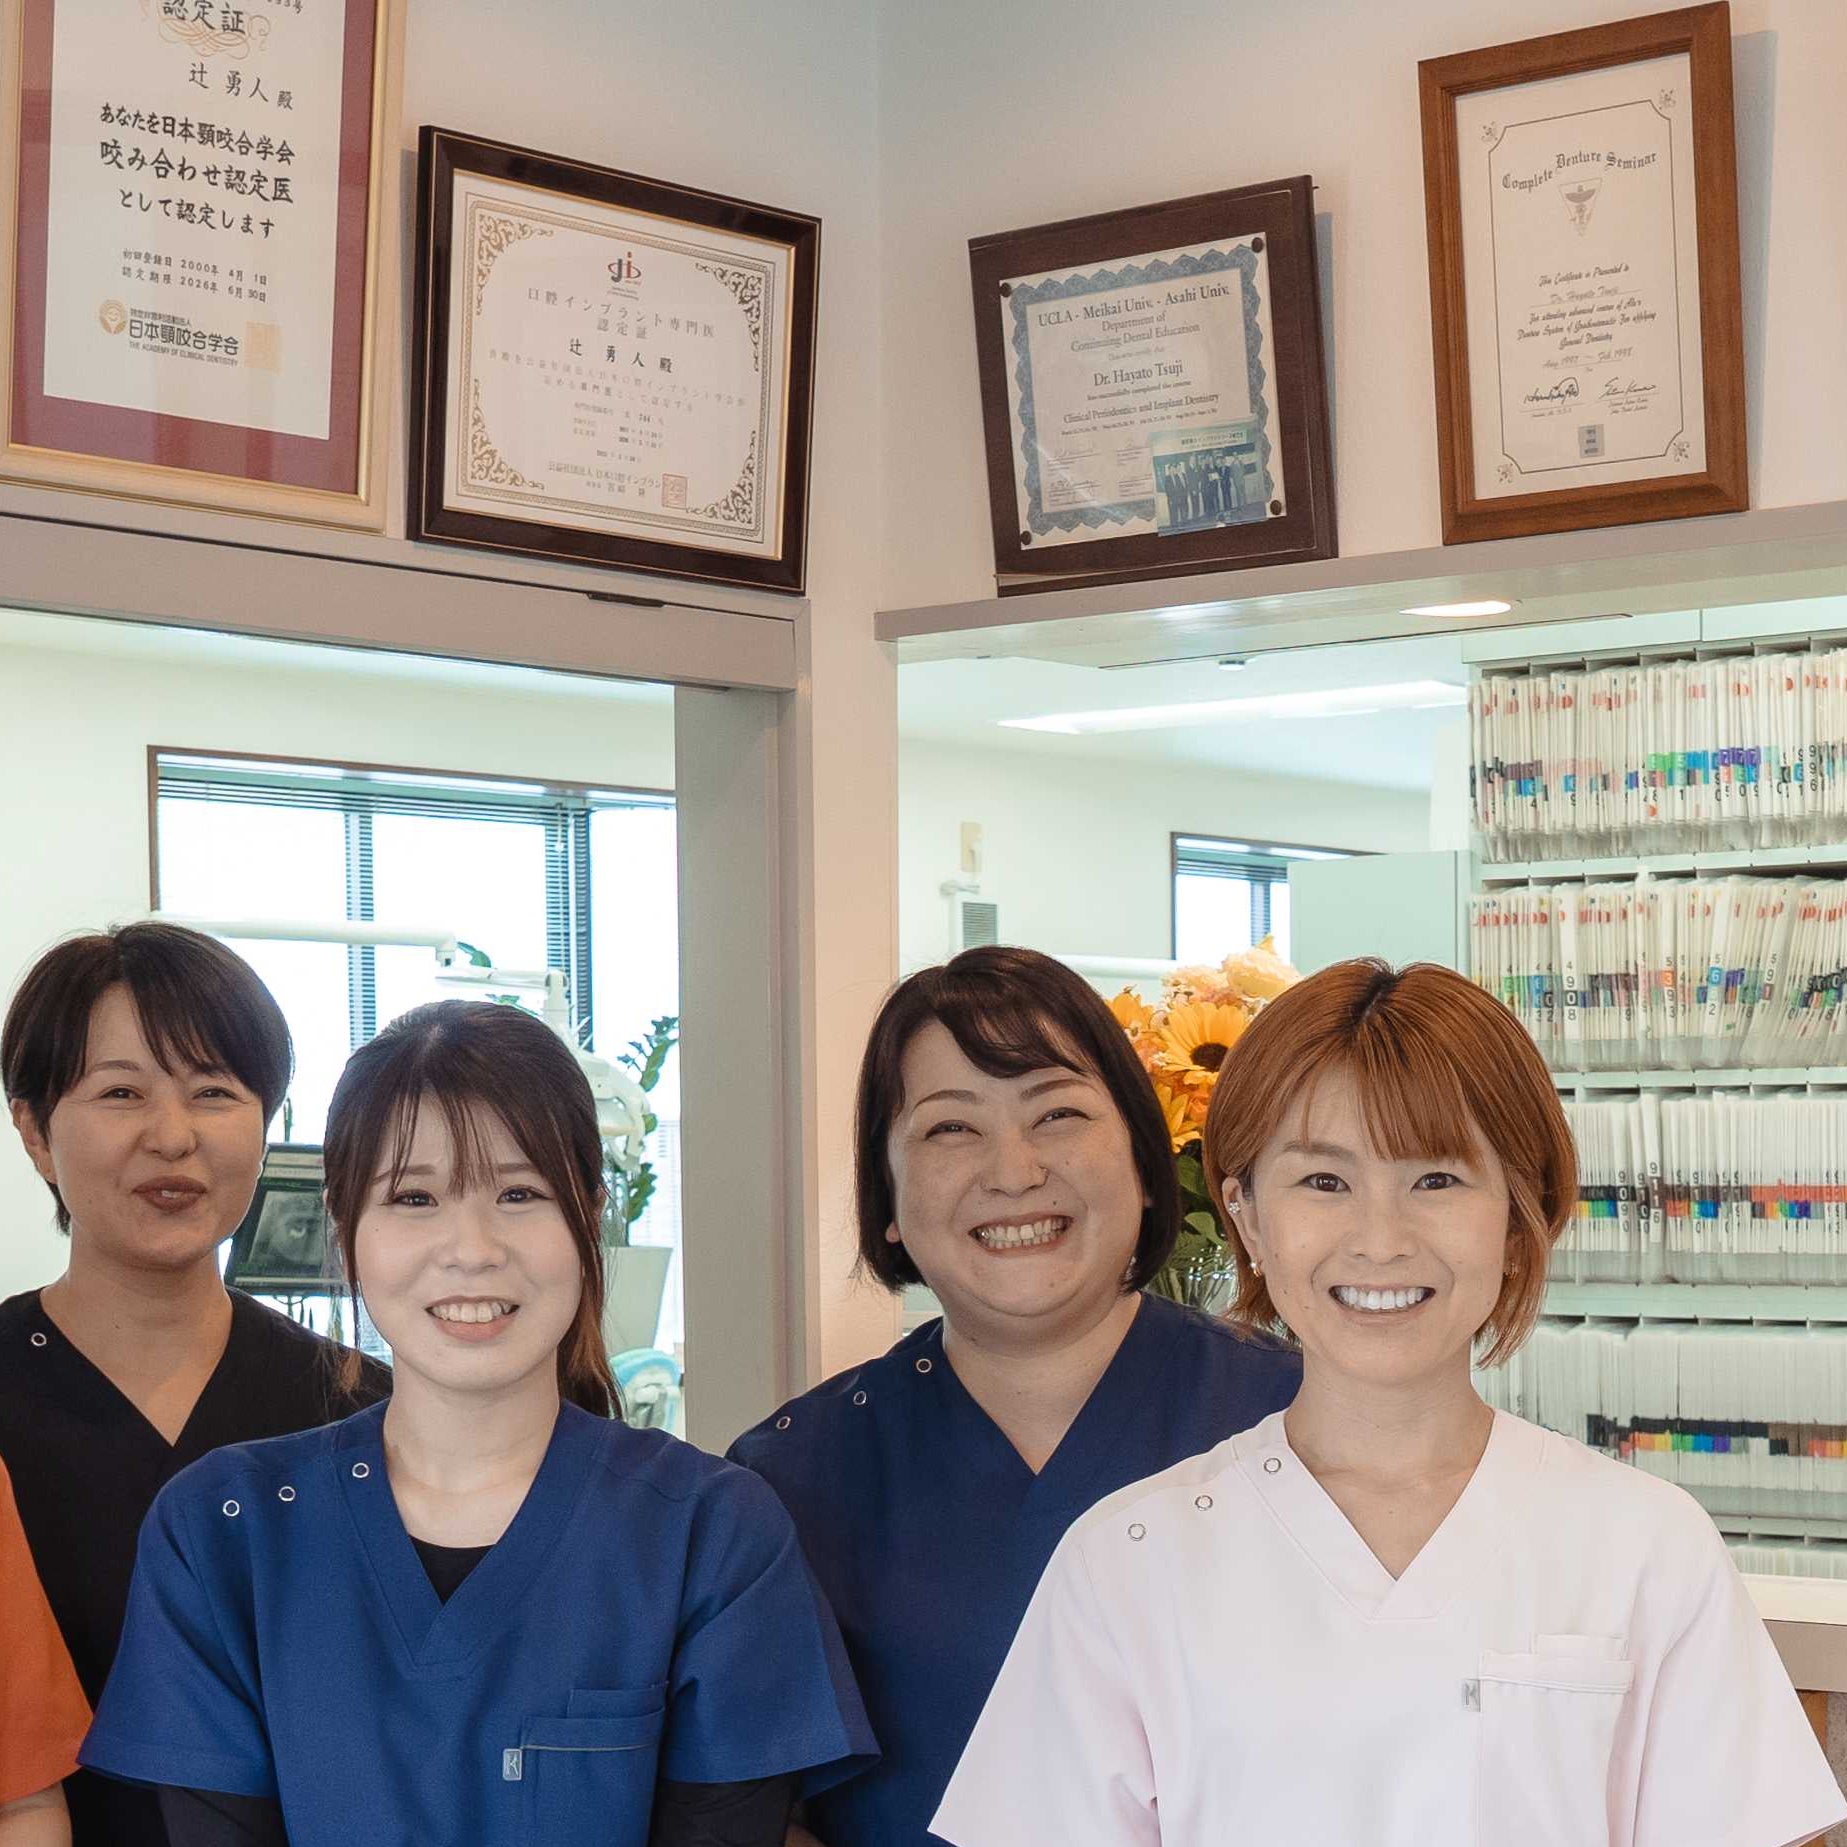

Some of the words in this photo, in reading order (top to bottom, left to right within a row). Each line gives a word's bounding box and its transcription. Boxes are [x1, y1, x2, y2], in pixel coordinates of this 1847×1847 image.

[189, 62, 209, 88] 辻
[226, 71, 268, 102] 勇人
[101, 103, 295, 165] あなたを日本顎咬合学会
[101, 138, 294, 204] 咬み合わせ認定医
[1501, 168, 1554, 194] Complete
[1555, 149, 1602, 170] Denture
[119, 189, 275, 239] として認定します
[1037, 310, 1074, 328] UCLA
[1083, 301, 1122, 320] Meikai
[1164, 287, 1197, 306] Asahi
[129, 318, 239, 357] 日本顎咬合学会
[1093, 371, 1112, 387] Dr.
[1113, 366, 1154, 385] Hayato
[1153, 358, 1184, 379] Tsuji
[1565, 960, 1579, 1022] 4908
